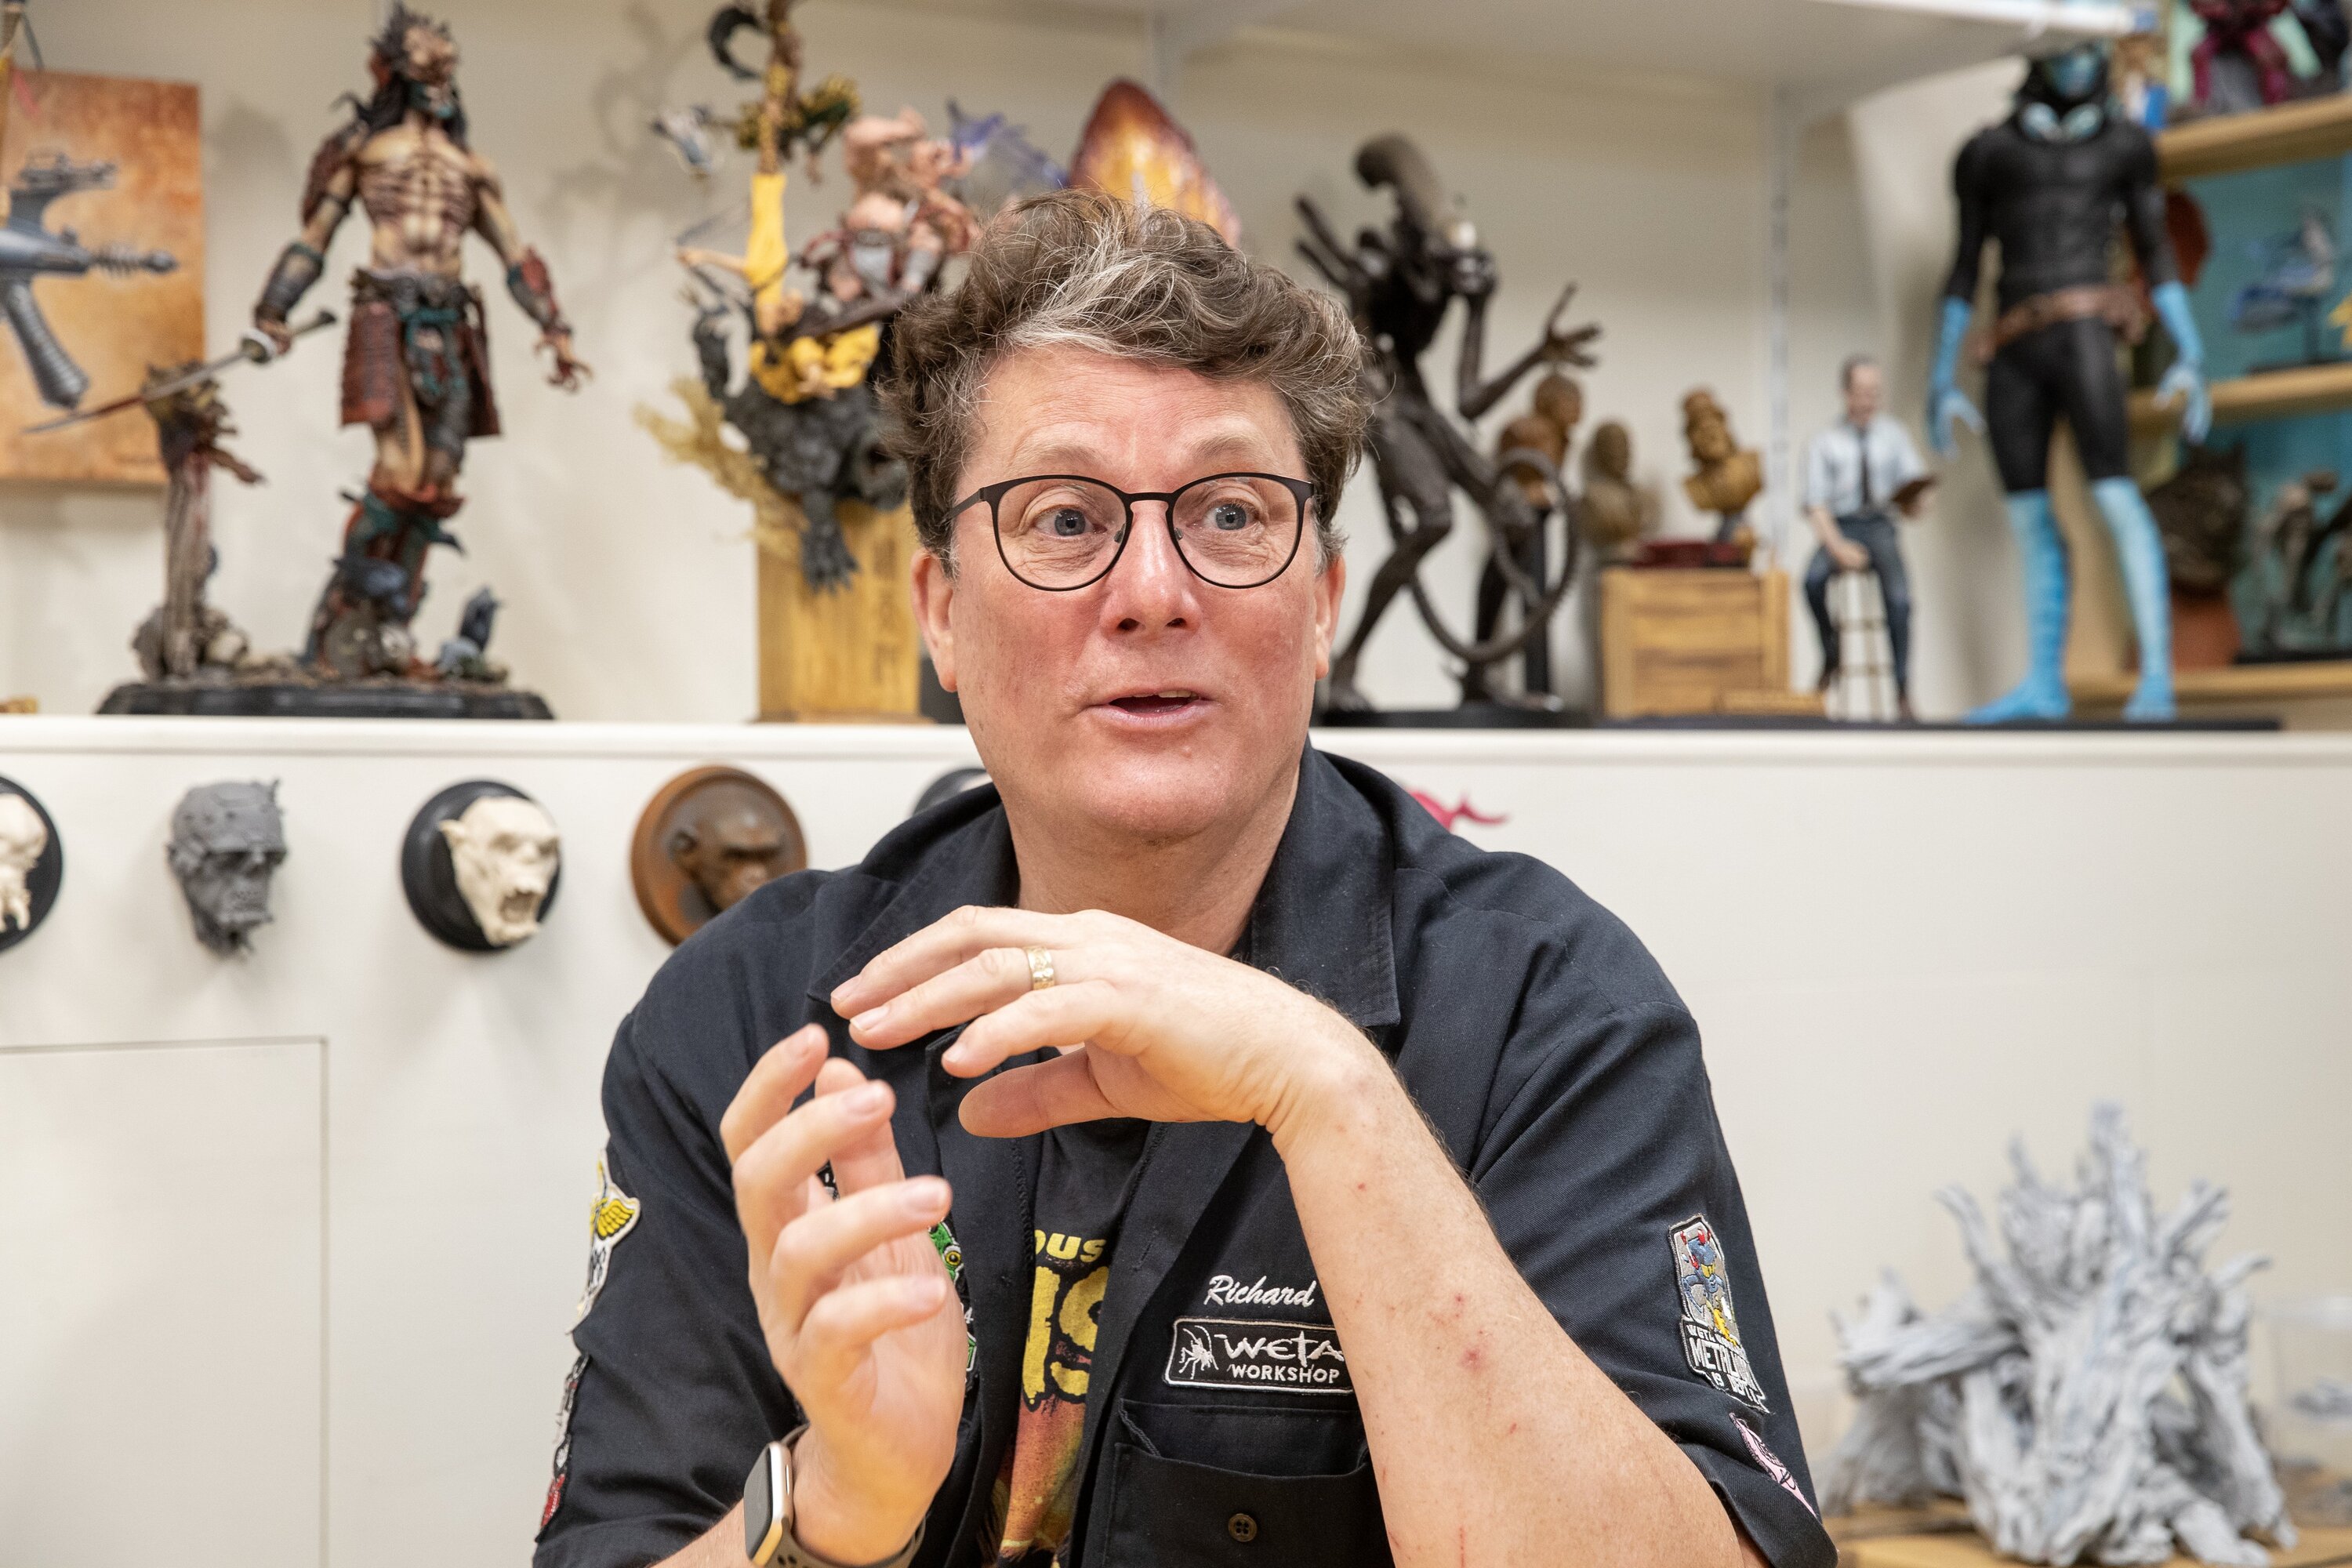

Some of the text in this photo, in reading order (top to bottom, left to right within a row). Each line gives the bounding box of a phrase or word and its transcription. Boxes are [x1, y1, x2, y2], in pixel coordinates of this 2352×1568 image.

[1203, 1275, 1316, 1307] Richard
[1214, 1330, 1345, 1367] WETA
[1226, 1363, 1340, 1384] WORKSHOP
